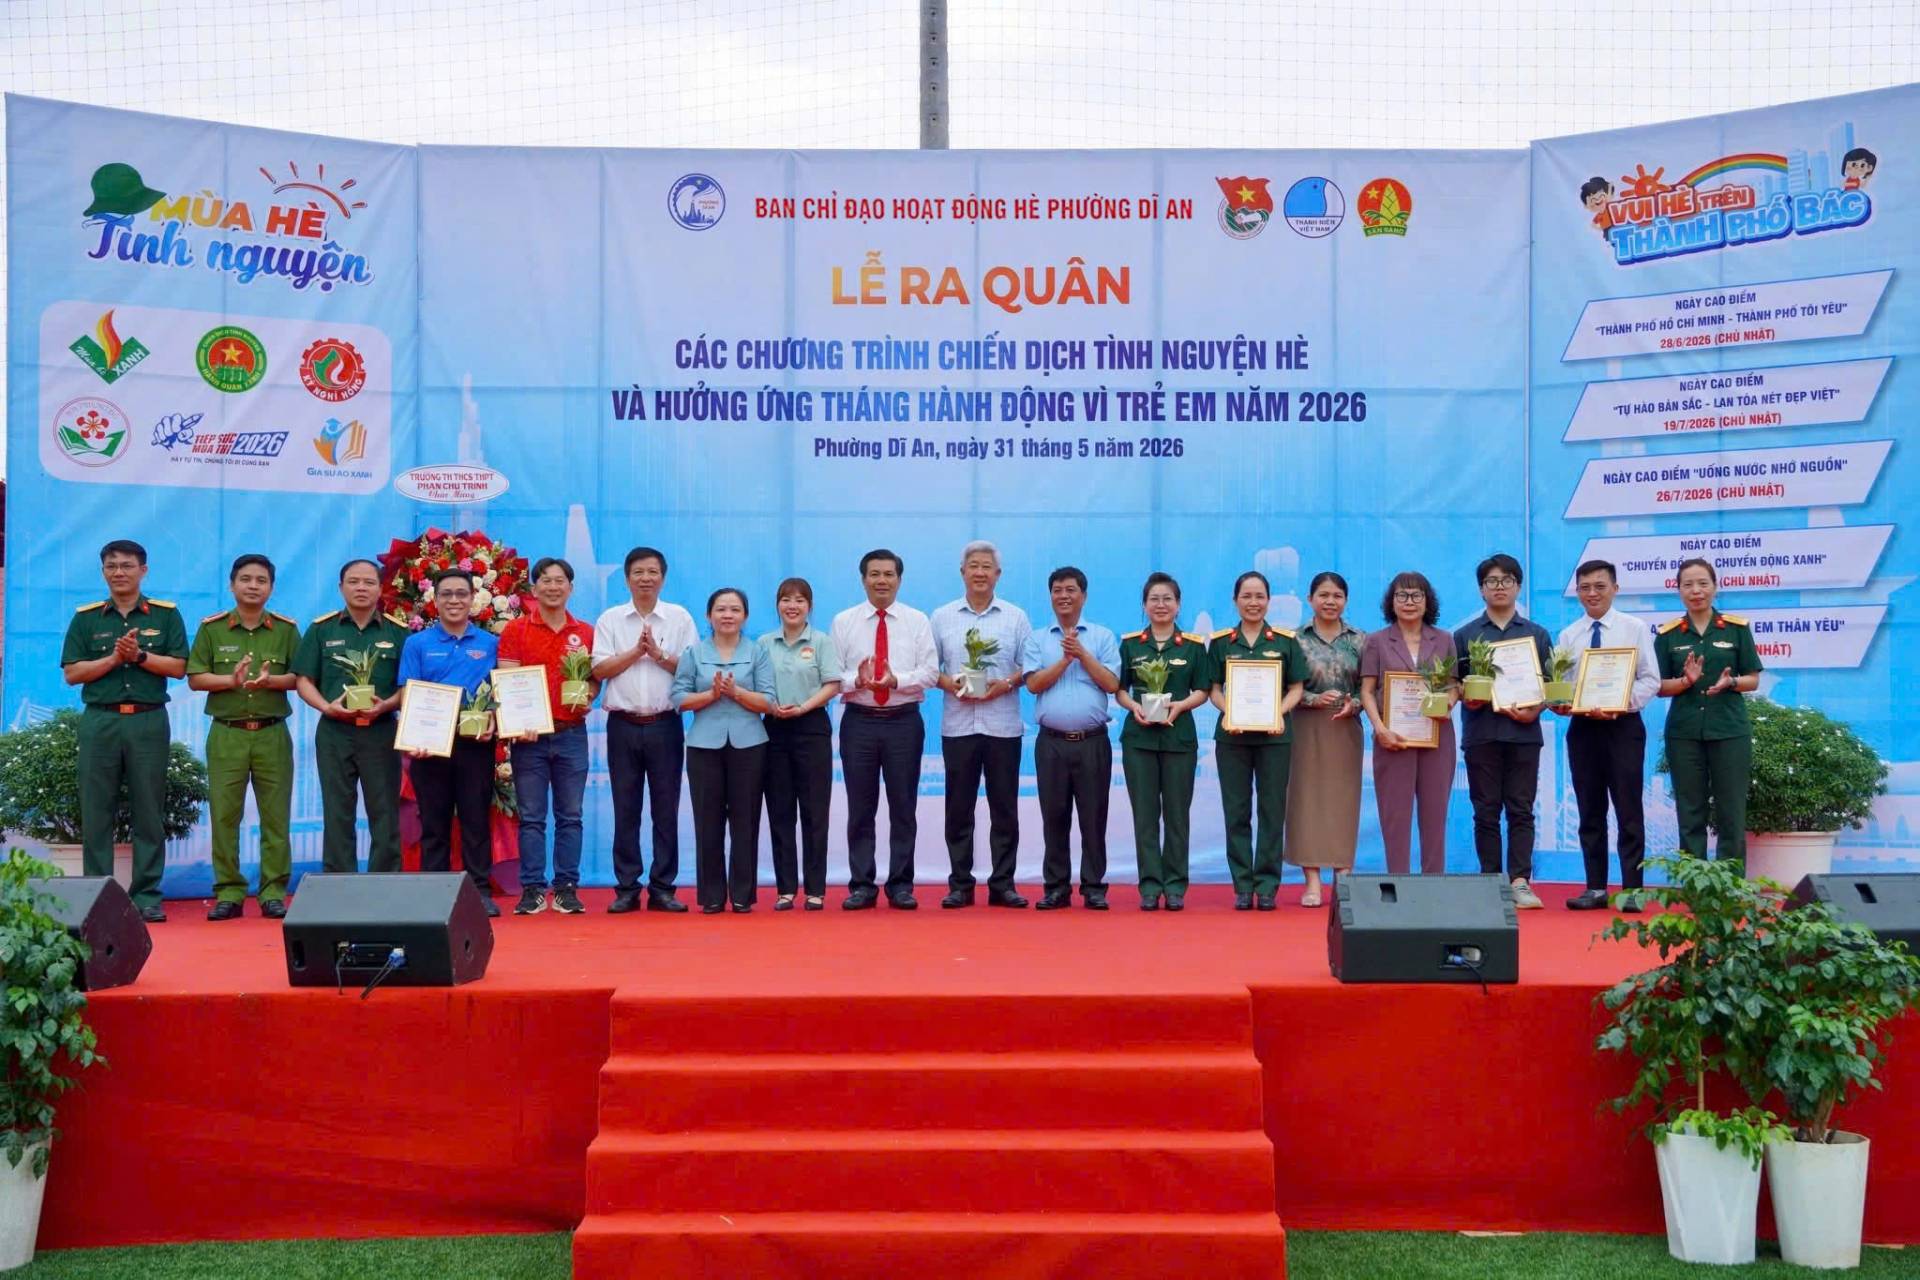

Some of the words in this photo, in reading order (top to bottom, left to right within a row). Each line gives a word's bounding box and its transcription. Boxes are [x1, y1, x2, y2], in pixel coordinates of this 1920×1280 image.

[150, 190, 252, 231] MÙA
[266, 202, 326, 238] HÈ
[755, 198, 795, 219] BAN
[803, 190, 837, 219] CHỈ
[844, 198, 885, 224] ĐẠO
[893, 198, 945, 224] HOẠT
[951, 193, 1006, 224] ĐỘNG
[1014, 193, 1040, 219] HÈ
[1048, 193, 1131, 219] PHƯỜNG
[1139, 193, 1159, 219] DĨ
[1166, 198, 1193, 219] AN
[1610, 196, 1654, 226] VUI
[1660, 187, 1693, 216] HÈ
[1699, 187, 1748, 210] TRÊN
[1611, 211, 1723, 259] THÀNH
[1727, 193, 1791, 240] PHỐ
[1795, 189, 1866, 229] BÁC
[88, 213, 194, 267] Tình
[207, 240, 371, 291] nguyện
[832, 250, 887, 305] LỄ
[900, 266, 970, 305] RA
[983, 256, 1130, 313] QUÂN
[1675, 297, 1702, 310] NGÀY
[1705, 295, 1726, 307] CAO
[1729, 289, 1756, 304] ĐIỂM
[1635, 318, 1656, 332] PHỐ
[1677, 315, 1695, 329] CHÍ
[1698, 314, 1725, 327] MINH
[1736, 309, 1771, 323] THÀNH
[1775, 304, 1797, 319] PHỐ
[1801, 304, 1818, 317] TÔI
[1660, 335, 1711, 349] 28/6/2026
[1714, 329, 1740, 346] (CHỦ
[1744, 328, 1775, 341] NHẬT)
[112, 348, 146, 376] XANH
[675, 333, 727, 370] CÁC
[736, 337, 844, 370] CHƯƠNG
[852, 335, 929, 370] TRÌNH
[938, 330, 1016, 370] CHIẾN
[1025, 340, 1085, 377] DỊCH
[1094, 334, 1152, 370] TÌNH
[1162, 333, 1264, 377] NGUYỆN
[1276, 334, 1309, 370] HÈ
[1680, 378, 1707, 391] NGÀY
[1710, 378, 1732, 389] CAO
[1736, 372, 1764, 387] ĐIỂM
[611, 384, 646, 421] VÀ
[655, 381, 747, 422] HƯỞNG
[757, 385, 813, 422] ỨNG
[821, 385, 909, 422] THÁNG
[919, 385, 991, 422] HÀNH
[1000, 385, 1074, 428] ĐỘNG
[1085, 385, 1108, 422] VÌ
[1117, 381, 1166, 422] TRẺ
[1175, 391, 1216, 422] EM
[1226, 385, 1289, 422] NĂM
[1299, 391, 1367, 422] 2026
[1634, 401, 1655, 414] HÀO
[1713, 397, 1734, 408] LAN
[1761, 391, 1782, 404] NÉT
[1785, 391, 1807, 405] ĐẸP
[1664, 416, 1716, 431] 19/7/2026
[1719, 412, 1746, 428] (CHỦ
[1749, 411, 1782, 427] NHẬT)
[231, 432, 286, 455] 2026
[814, 437, 882, 460] Phường
[888, 437, 906, 457] Dĩ
[911, 438, 940, 460] An,
[946, 436, 988, 460] ngày
[994, 438, 1014, 457] 31
[1022, 438, 1072, 460] tháng
[1078, 438, 1089, 457] 5
[1095, 437, 1133, 457] năm
[1139, 438, 1184, 457] 2026
[1603, 470, 1632, 484] NGÀY
[1635, 470, 1658, 482] CAO
[1661, 465, 1690, 481] ĐIỂM
[1734, 462, 1767, 476] NƯỚC
[1656, 488, 1712, 502] 26/7/2026
[1717, 483, 1745, 500] (CHỦ
[1749, 482, 1785, 498] NHẬT)
[1680, 538, 1706, 550] NGÀY
[1710, 539, 1731, 549] CAO
[1734, 533, 1761, 548] ĐIỂM
[1715, 553, 1757, 568] CHUYỂN
[1760, 553, 1790, 568] ĐỘNG
[1720, 573, 1745, 588] (CHỦ
[1748, 573, 1781, 587] NHẬT)
[1755, 622, 1773, 633] EM
[1777, 618, 1810, 633] THÂN
